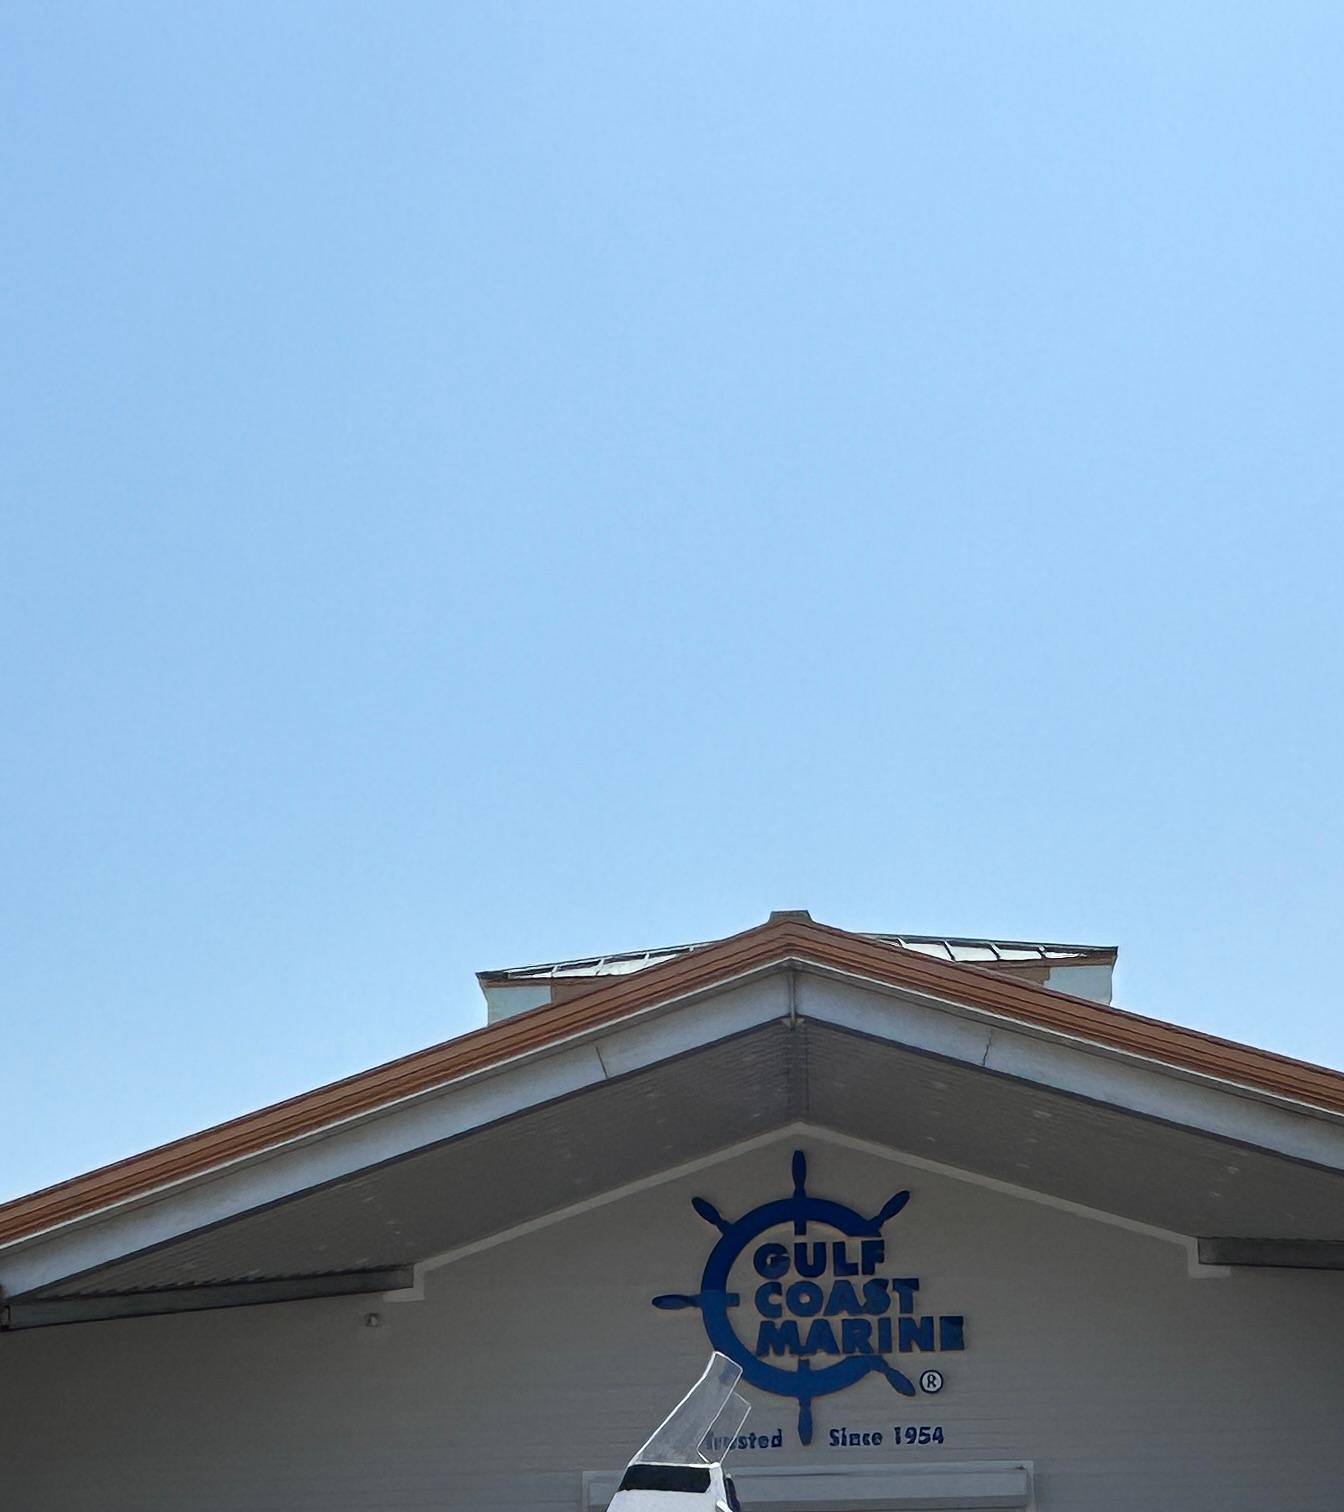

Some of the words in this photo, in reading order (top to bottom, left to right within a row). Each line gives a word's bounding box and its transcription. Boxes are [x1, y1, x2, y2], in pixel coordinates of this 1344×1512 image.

[753, 1239, 886, 1279] GULF
[754, 1278, 920, 1318] COAST
[756, 1315, 965, 1357] MARINE
[828, 1427, 883, 1447] Since
[893, 1426, 945, 1446] 1954
